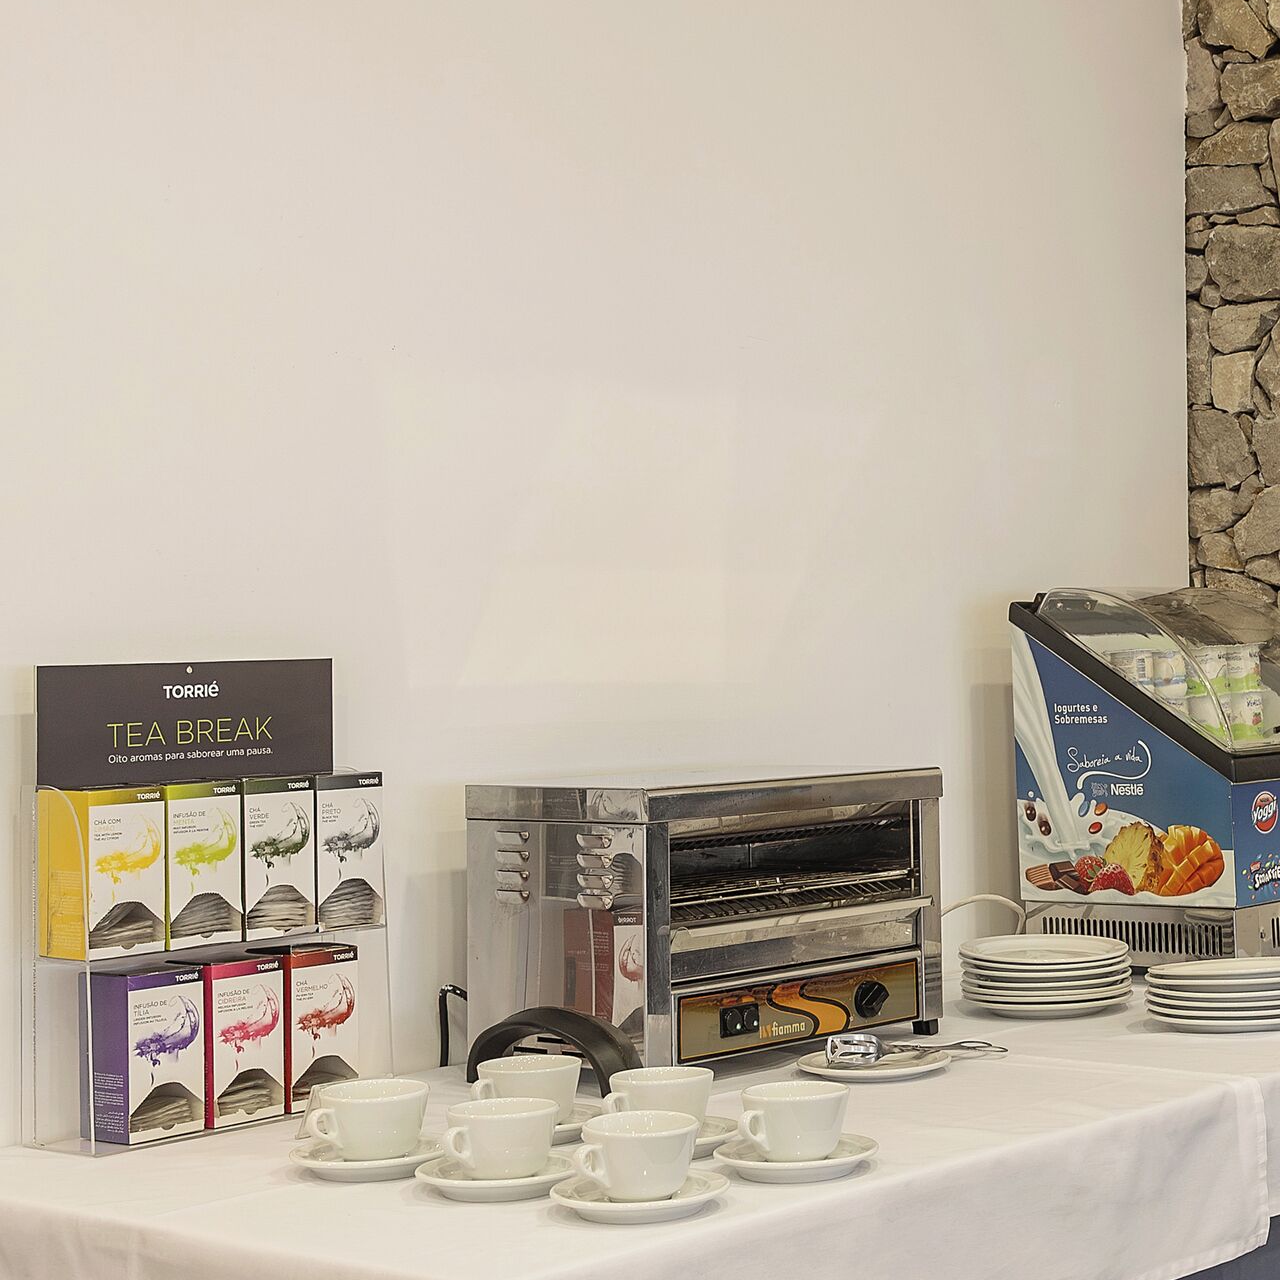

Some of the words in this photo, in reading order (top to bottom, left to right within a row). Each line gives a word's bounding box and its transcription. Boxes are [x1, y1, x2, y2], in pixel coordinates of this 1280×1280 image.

[1054, 703, 1091, 715] Iogurtes
[1092, 704, 1098, 712] e
[1054, 714, 1108, 724] Sobremesas
[107, 721, 167, 748] TEA
[176, 716, 273, 745] BREAK
[108, 753, 128, 764] Oito
[130, 753, 163, 762] aromas
[165, 752, 185, 762] para
[187, 749, 224, 759] saborear
[226, 748, 245, 757] uma
[246, 746, 273, 757] pausa.
[1067, 746, 1112, 772] Saboreia
[1114, 753, 1122, 761] a
[1125, 746, 1143, 762] vida
[771, 1021, 806, 1036] fiamma
